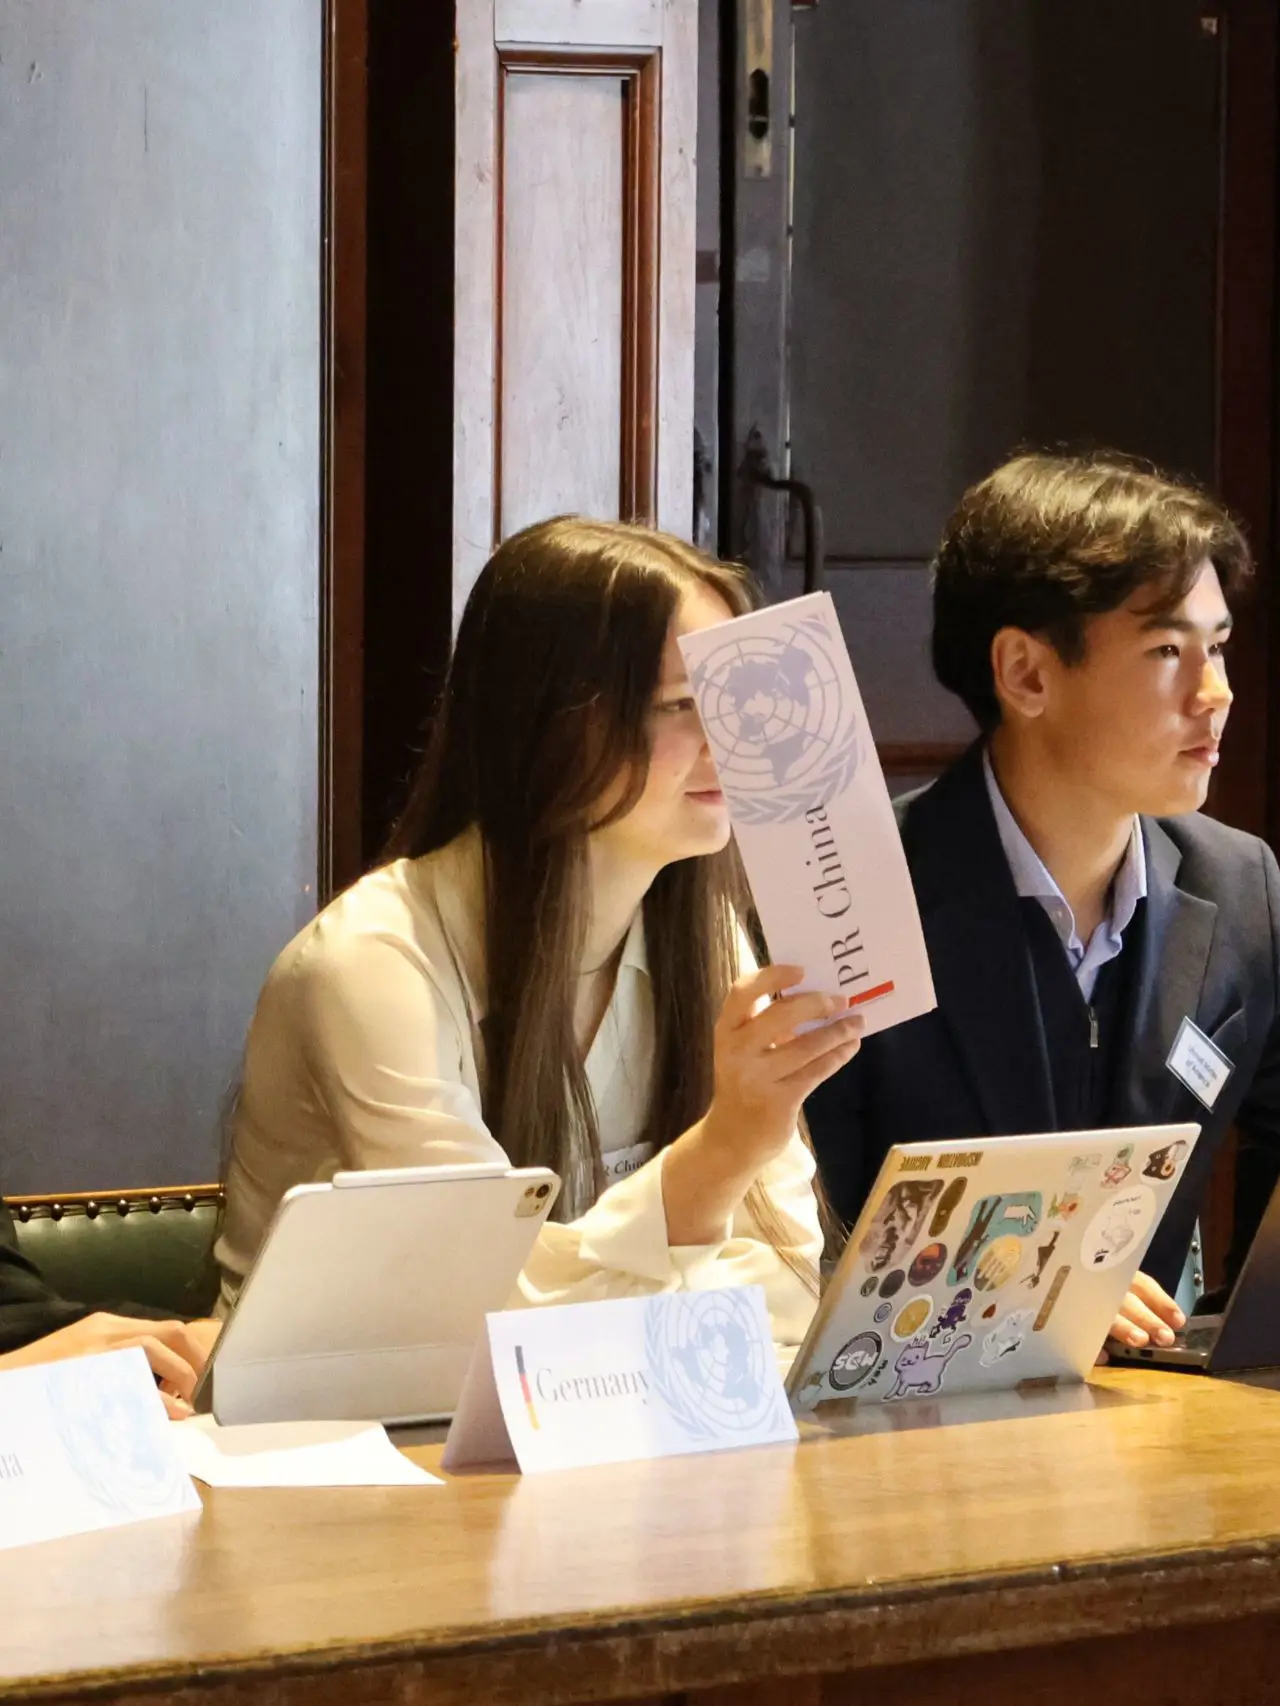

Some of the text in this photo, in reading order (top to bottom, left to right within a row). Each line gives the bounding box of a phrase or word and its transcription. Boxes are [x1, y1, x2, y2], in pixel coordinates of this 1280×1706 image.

[805, 802, 869, 987] PR China
[536, 1367, 650, 1405] Germany
